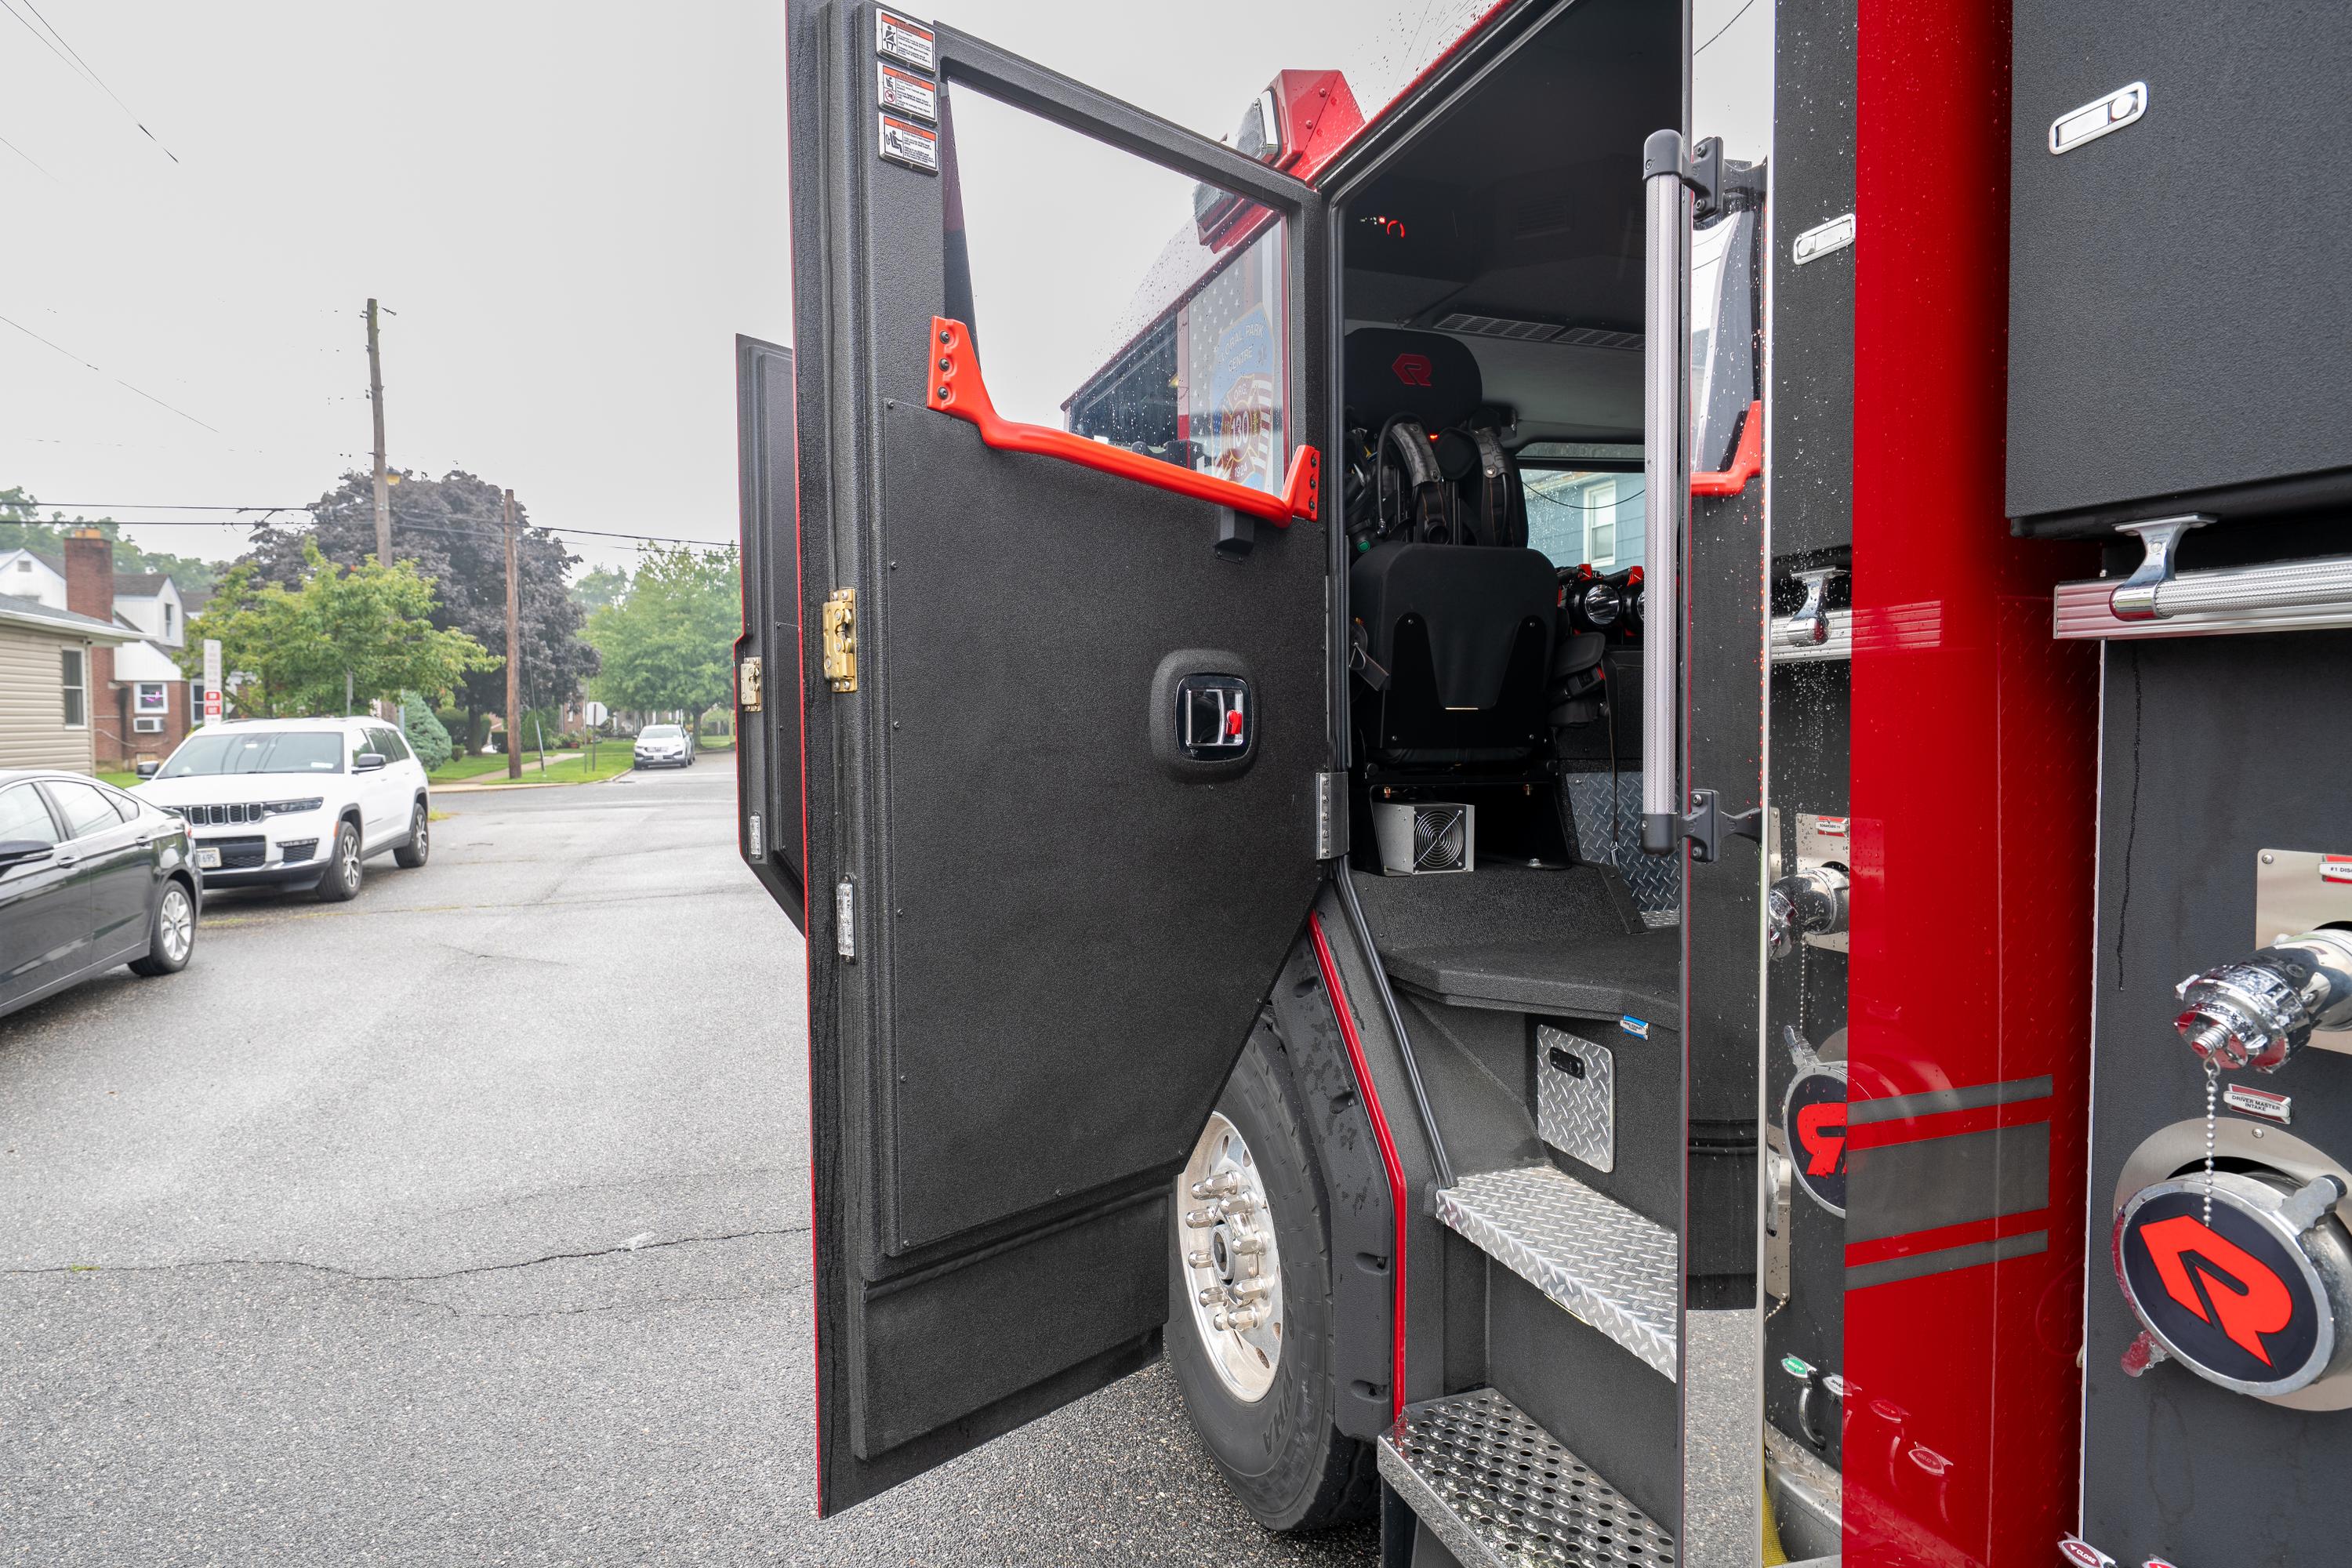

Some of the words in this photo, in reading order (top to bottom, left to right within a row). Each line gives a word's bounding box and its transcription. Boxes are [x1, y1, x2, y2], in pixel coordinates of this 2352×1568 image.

[898, 24, 921, 35] WARNING
[899, 72, 922, 85] WARNING
[901, 124, 924, 136] WARNING
[1246, 323, 1264, 338] PARK
[1229, 346, 1253, 372] CENTRE
[1232, 411, 1249, 449] 130
[1234, 462, 1247, 477] 1924
[2231, 1094, 2254, 1104] DRIVER
[2255, 1101, 2281, 1111] MASTER
[2245, 1102, 2267, 1112] INTAKE
[2076, 1549, 2097, 1565] CLOSE
